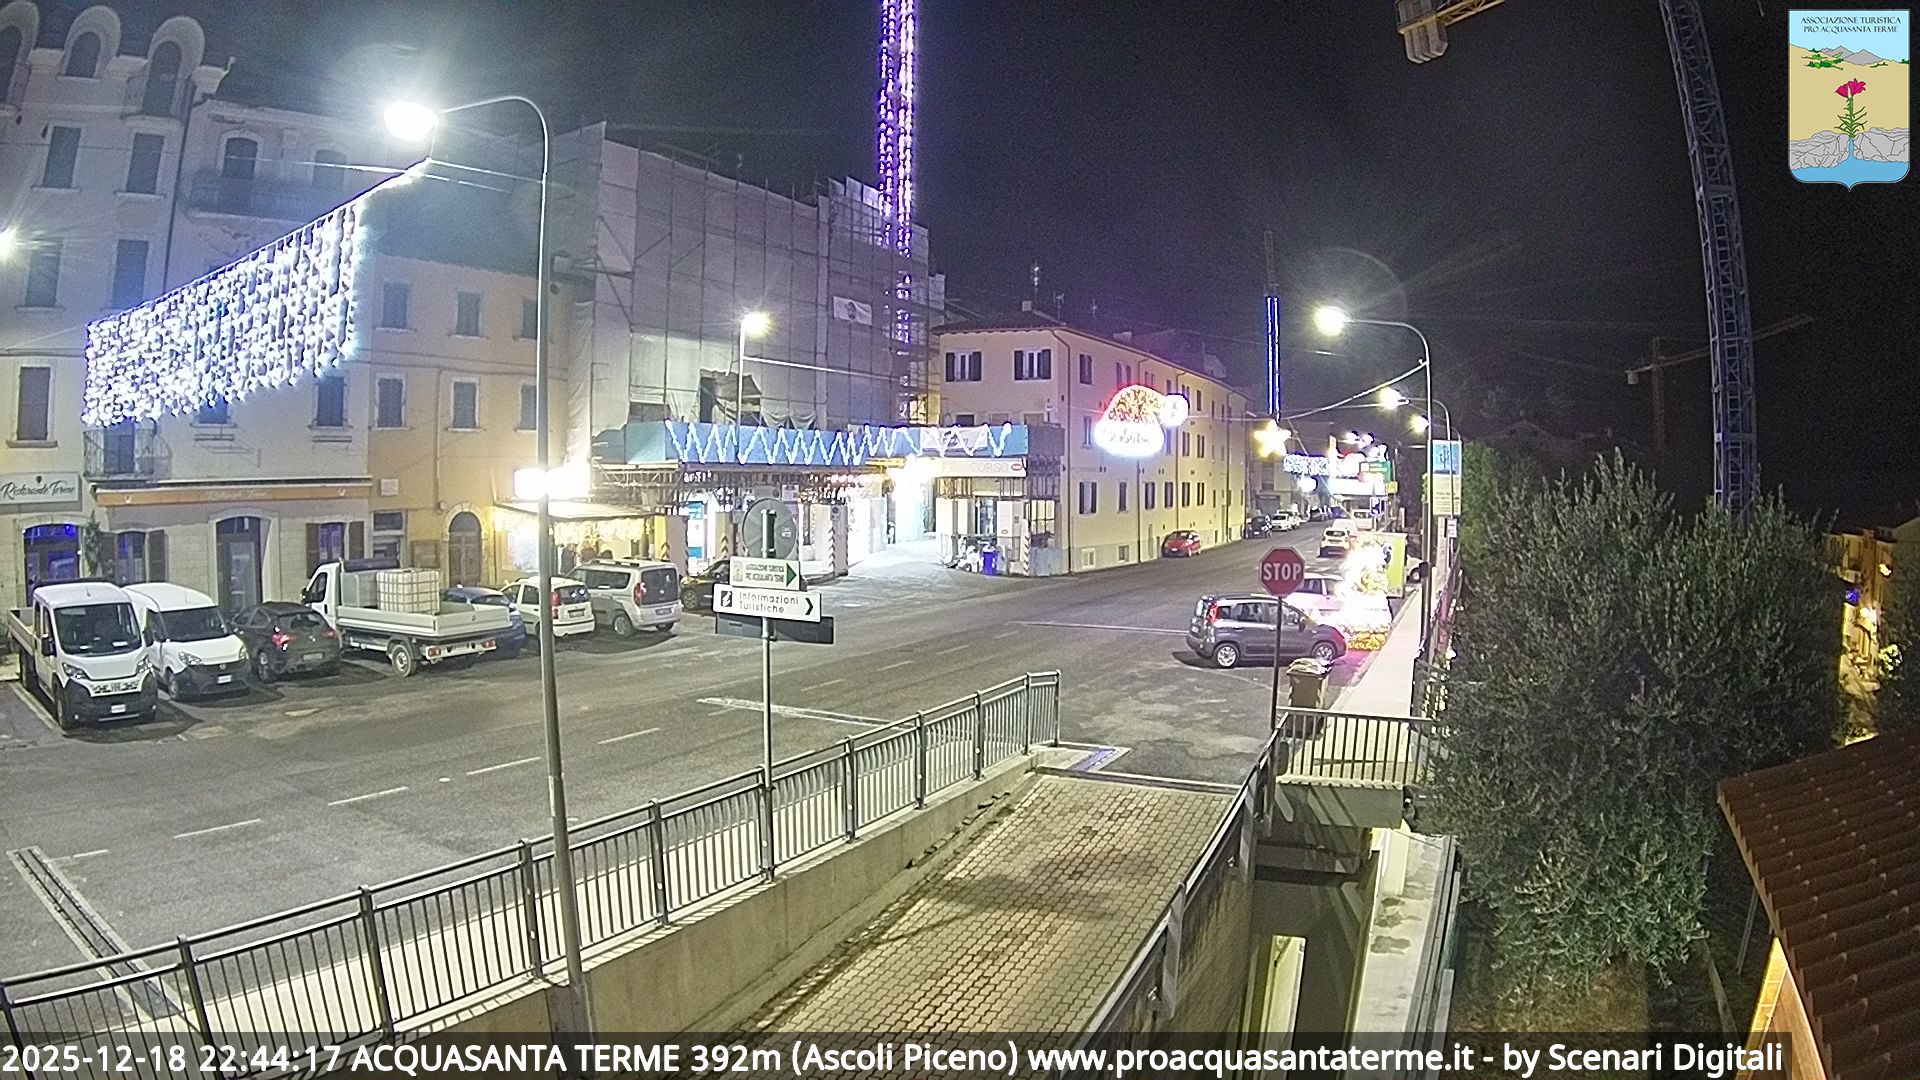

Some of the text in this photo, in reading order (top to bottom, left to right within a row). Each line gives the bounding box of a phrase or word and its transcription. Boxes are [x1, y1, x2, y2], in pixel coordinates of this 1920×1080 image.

[1263, 562, 1302, 581] STOP
[739, 591, 799, 606] Informazioni
[739, 601, 785, 614] Turistiche
